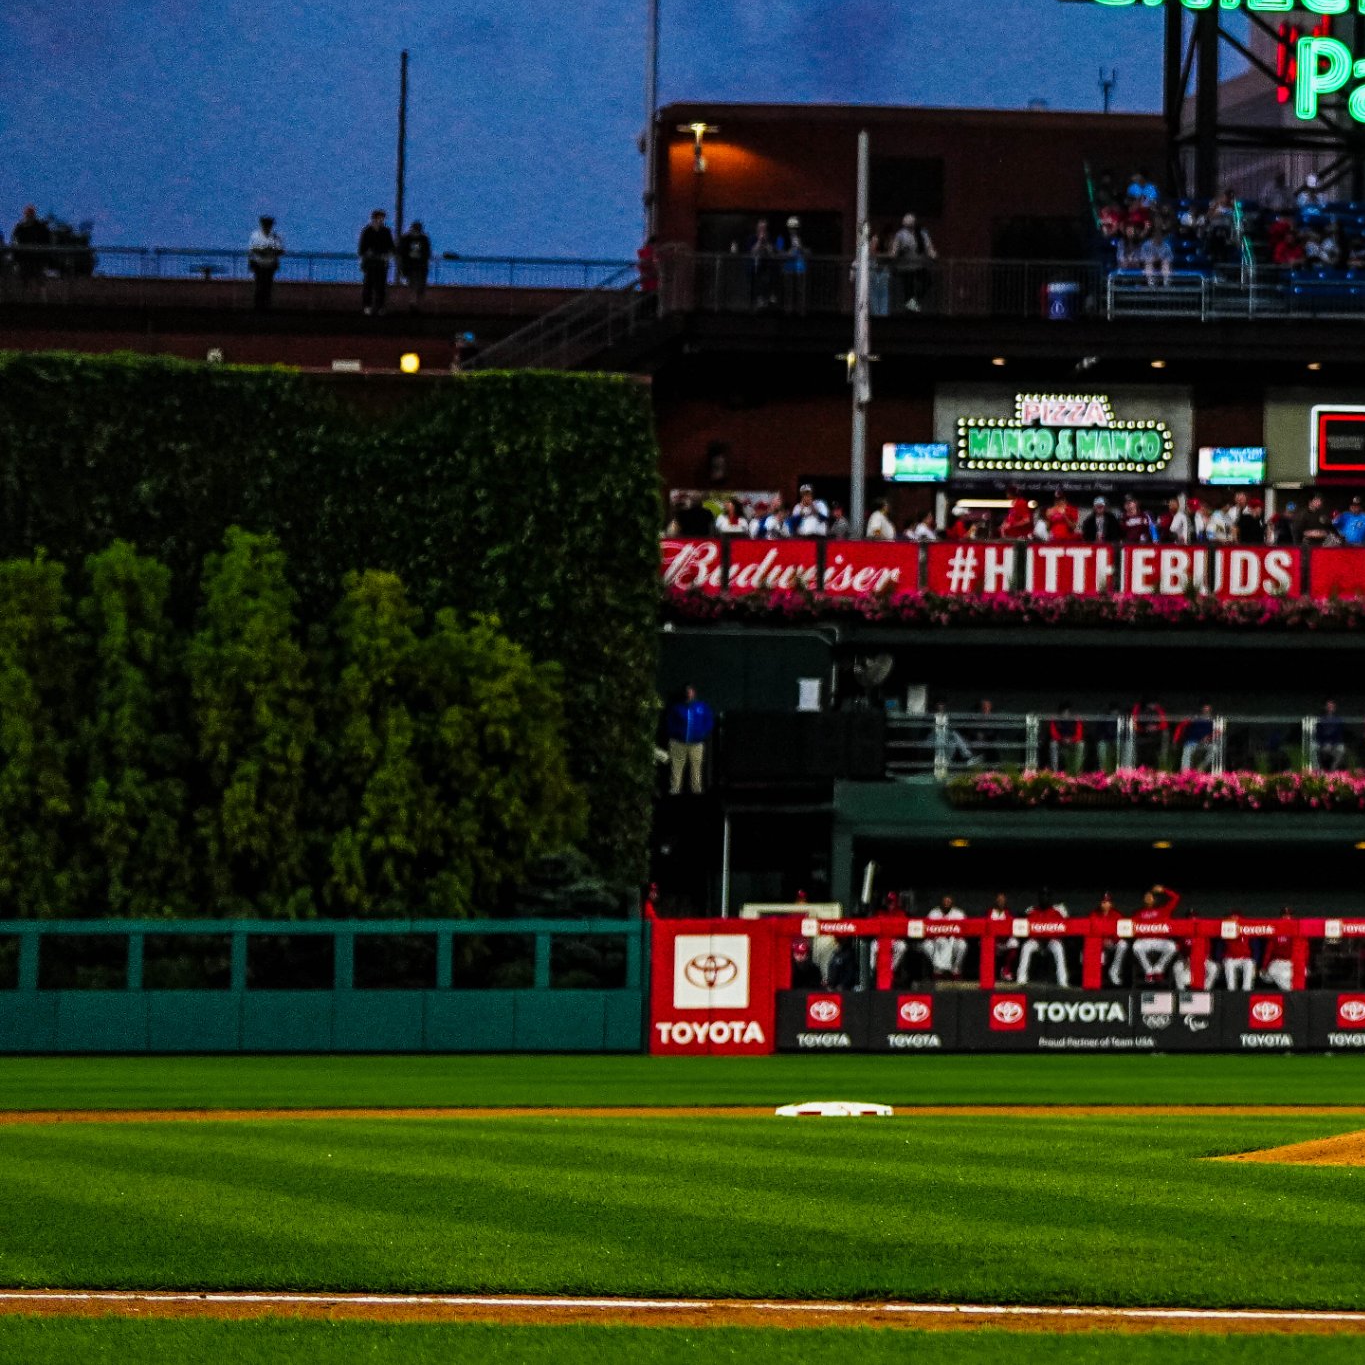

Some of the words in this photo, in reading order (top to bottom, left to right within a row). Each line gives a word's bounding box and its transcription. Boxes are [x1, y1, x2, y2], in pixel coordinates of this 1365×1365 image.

[1021, 401, 1106, 425] PIZZA
[969, 429, 1053, 459] MANCO
[1055, 431, 1073, 460] &
[1076, 430, 1162, 461] MANCO
[946, 546, 1293, 596] #HITTHEBUDS
[1034, 1001, 1126, 1024] TOYOTA
[656, 1020, 766, 1045] TOYOTA
[797, 1033, 850, 1048] TOYOTA
[887, 1034, 942, 1048] TOYOTA
[1039, 1036, 1065, 1047] Proud
[1067, 1036, 1098, 1047] Partner
[1100, 1036, 1109, 1047] of
[1111, 1036, 1133, 1047] Team
[1135, 1036, 1155, 1047] USA
[1240, 1033, 1294, 1048] TOYOTA
